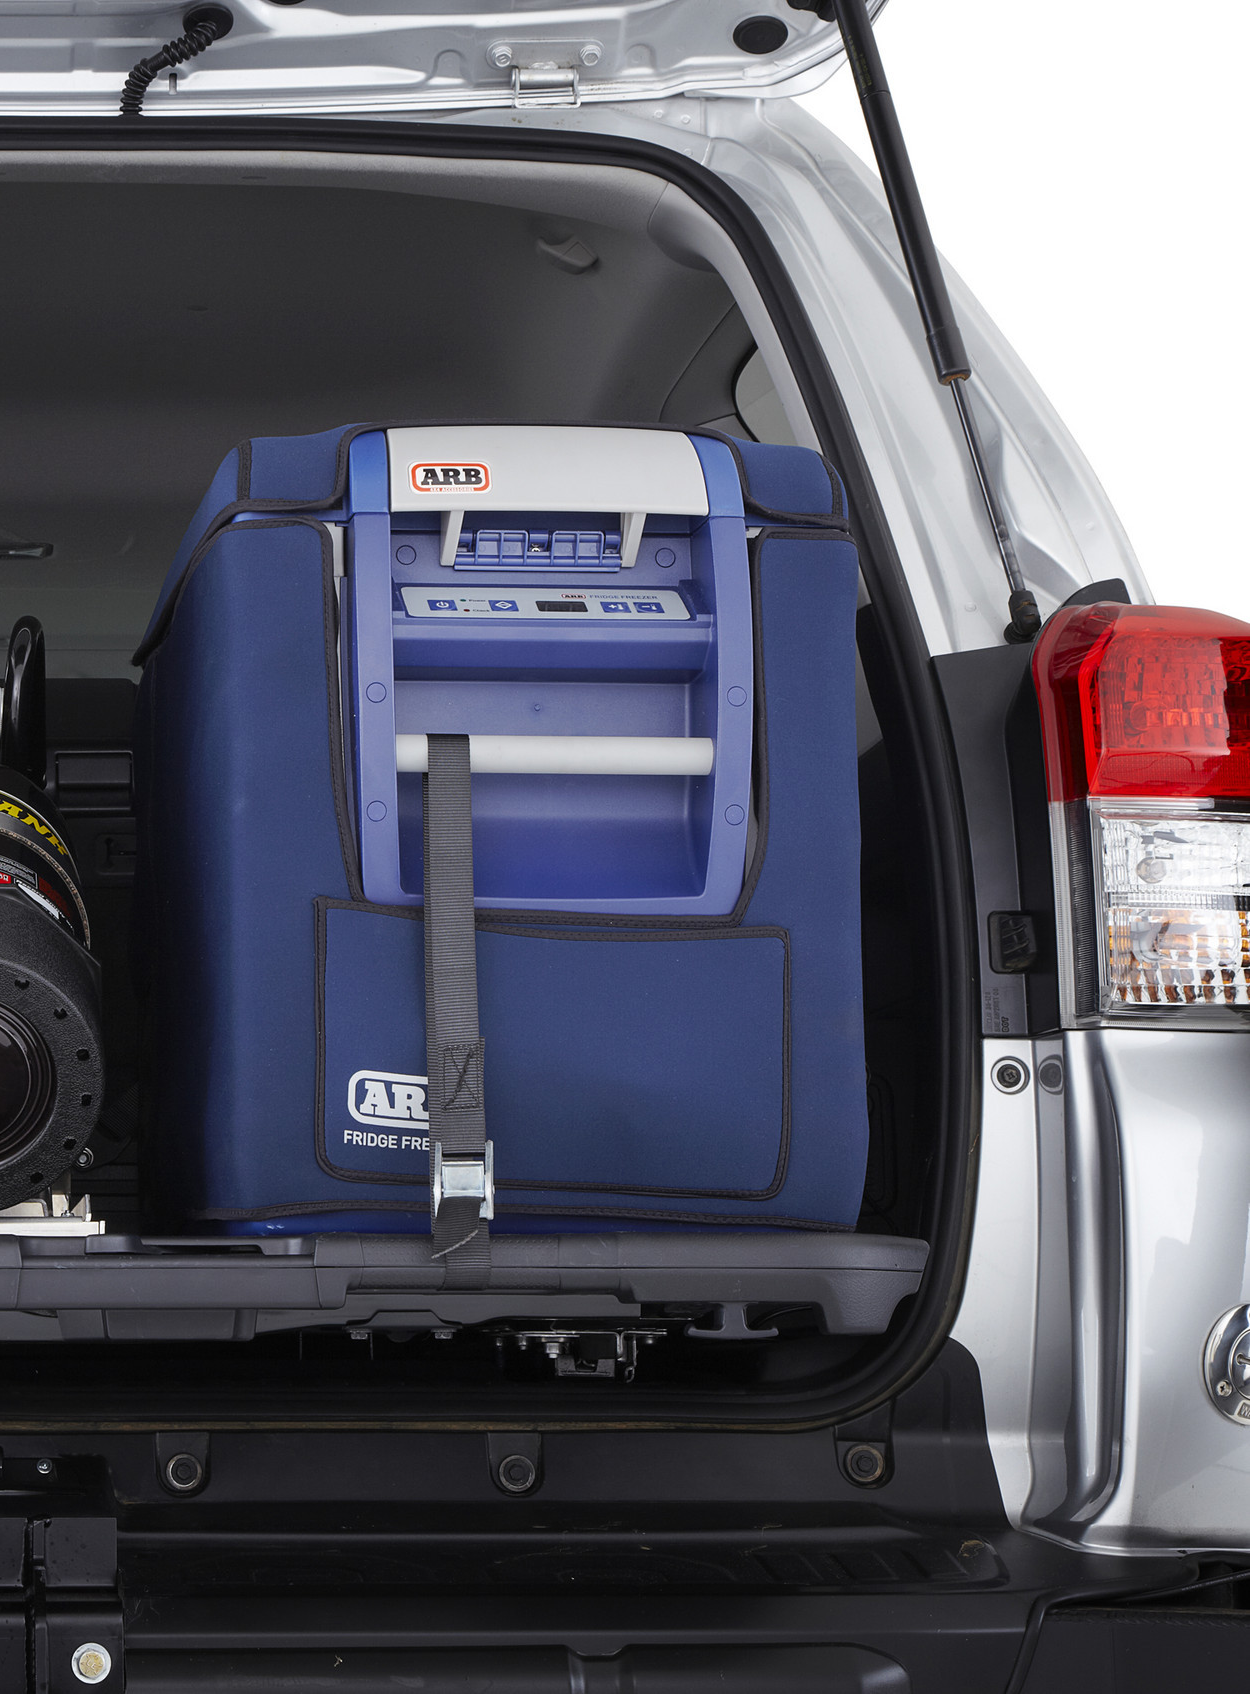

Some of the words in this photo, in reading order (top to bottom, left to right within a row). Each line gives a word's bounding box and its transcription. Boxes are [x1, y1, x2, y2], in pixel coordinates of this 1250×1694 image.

[421, 468, 482, 485] ARB
[359, 1080, 430, 1120] AR
[343, 1130, 398, 1149] FRIDGE
[401, 1136, 430, 1151] FRE
